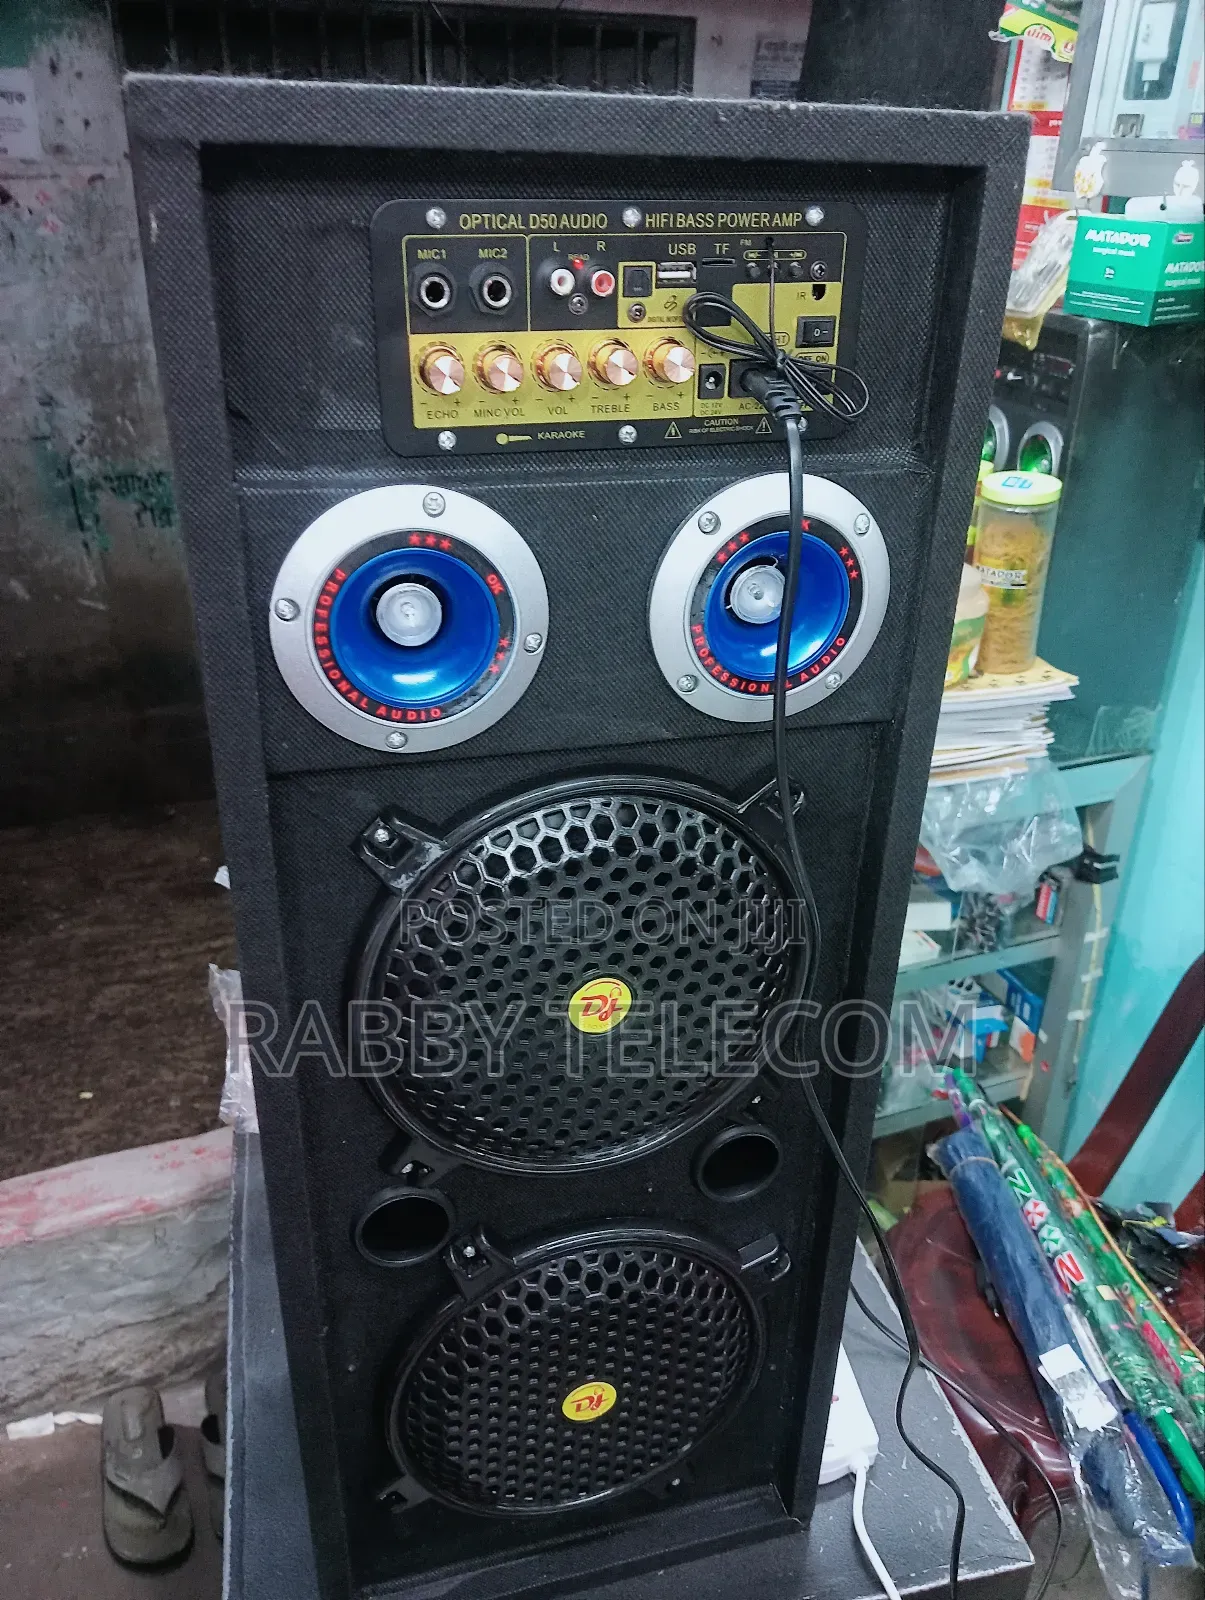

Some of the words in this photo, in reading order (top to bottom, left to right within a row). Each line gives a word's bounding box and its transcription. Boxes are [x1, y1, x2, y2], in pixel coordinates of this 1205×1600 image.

[459, 213, 526, 229] OPTICAL
[529, 213, 558, 229] D50
[560, 213, 608, 229] AUDIO
[645, 213, 674, 228] HIFI
[677, 213, 714, 228] BASS
[717, 213, 773, 228] POWER
[774, 213, 802, 228] AMP
[1085, 229, 1151, 247] MATADOR
[553, 241, 560, 252] L
[597, 240, 606, 252] R
[668, 243, 697, 255] USB
[714, 243, 730, 255] TF
[417, 248, 447, 260] MIC1
[478, 247, 508, 259] MIC2
[796, 291, 807, 300] IR
[503, 407, 525, 417] VOL
[548, 406, 568, 415] VOL
[591, 403, 630, 413] TREBLE
[652, 402, 680, 412] BASS
[427, 410, 459, 420] ECHO
[704, 418, 739, 427] CAUTION
[537, 430, 586, 440] KARAOKE
[314, 568, 369, 709] PROFESSIONAL
[376, 706, 442, 721] AUDIO
[691, 623, 792, 693] PROFESSIONL
[800, 637, 846, 682] AUDIO
